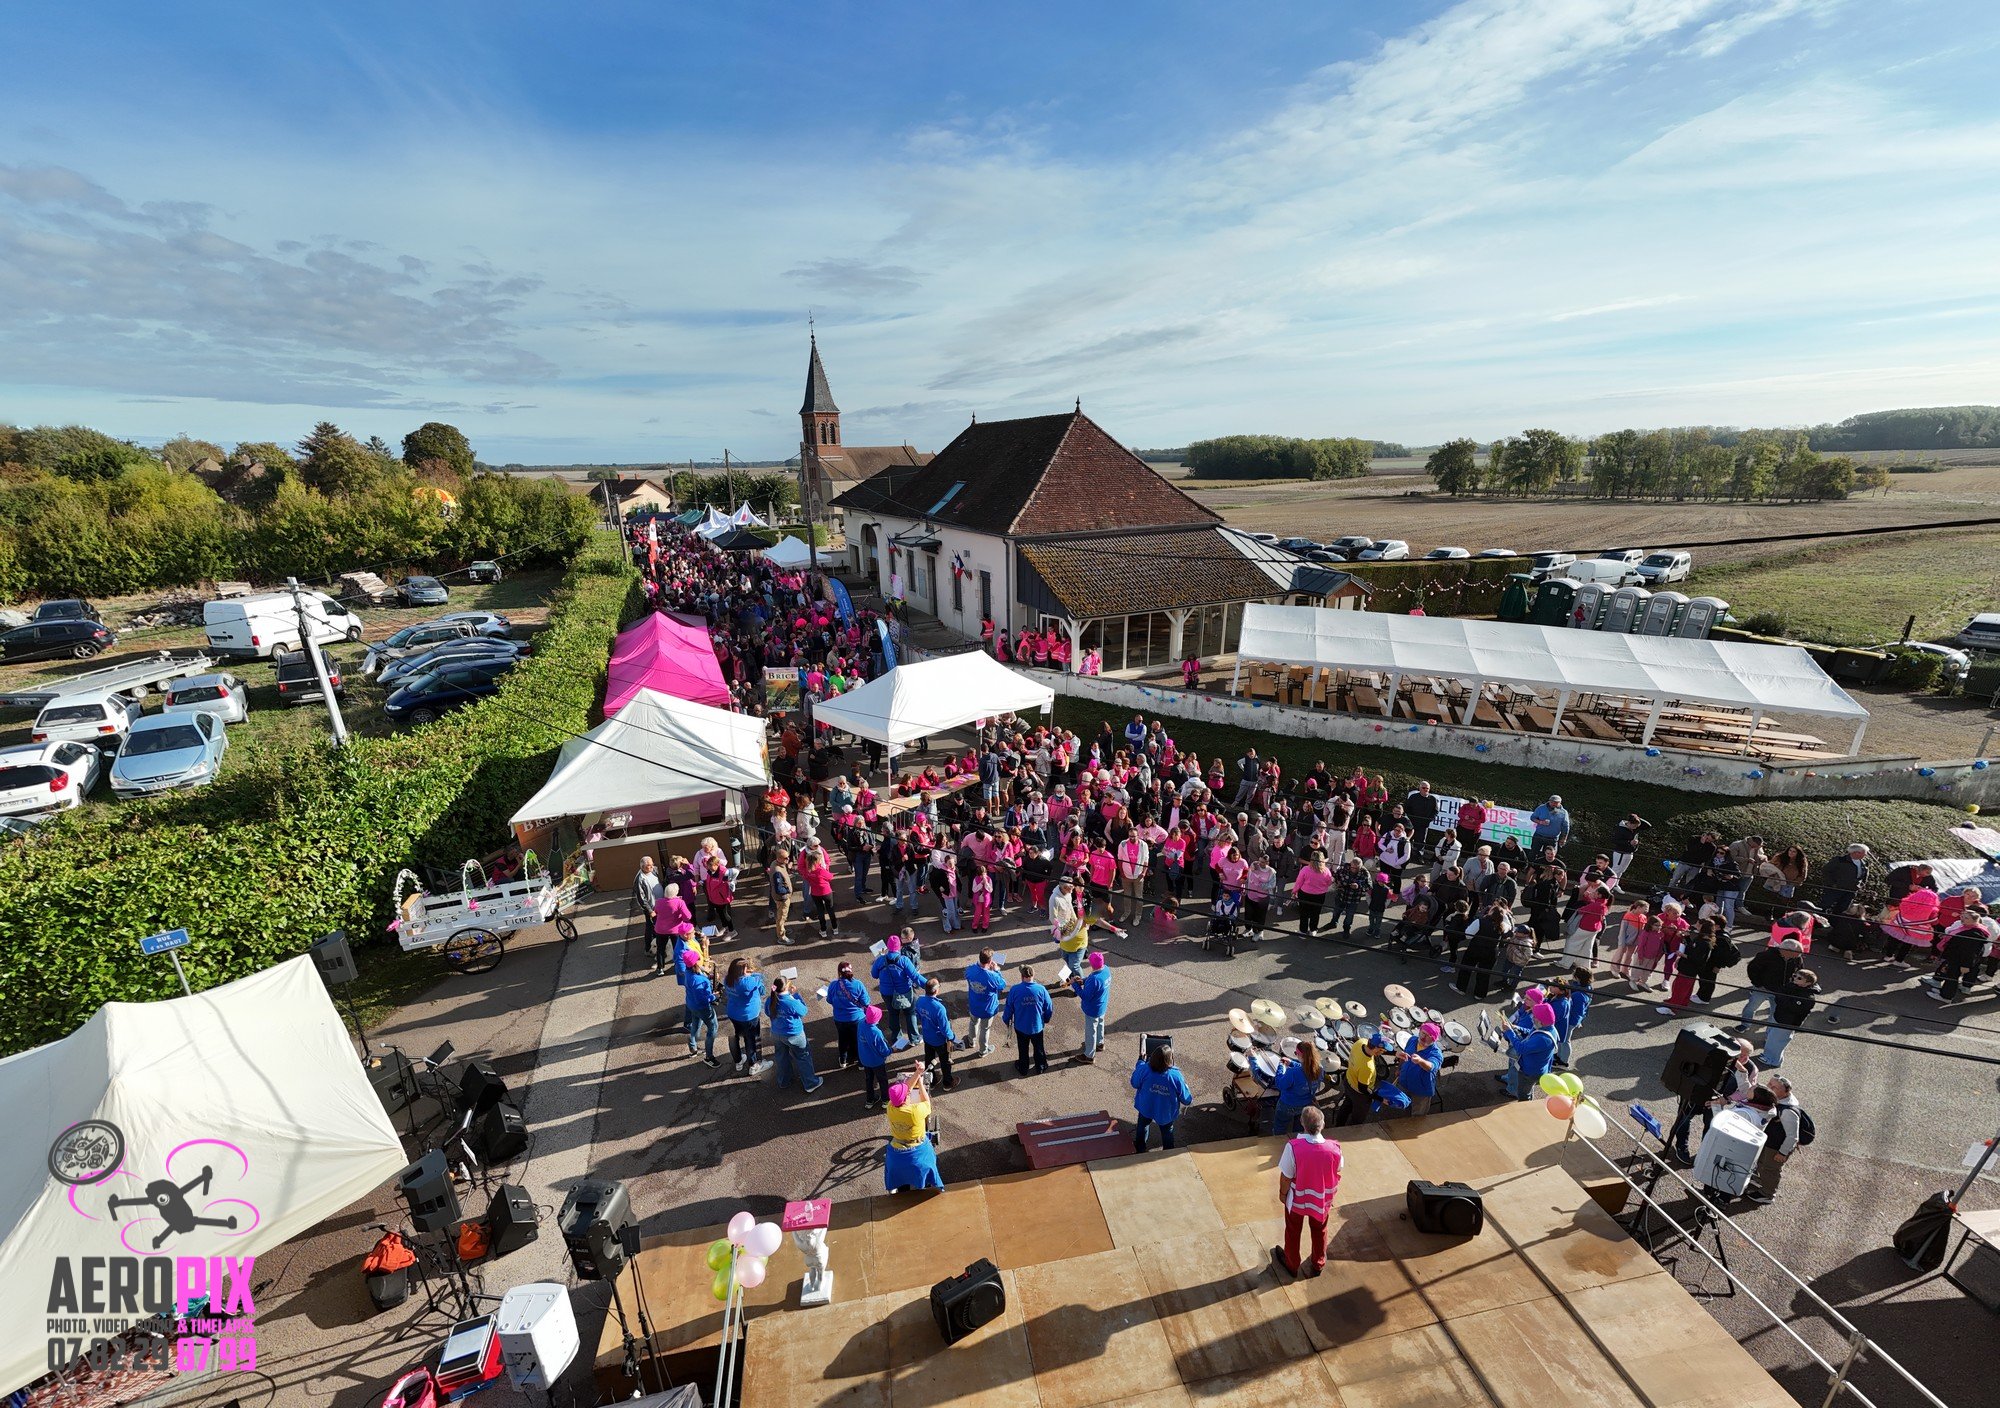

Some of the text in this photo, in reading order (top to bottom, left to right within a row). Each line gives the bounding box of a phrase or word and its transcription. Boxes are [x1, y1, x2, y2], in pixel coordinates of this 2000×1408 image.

[768, 672, 797, 680] BRICE
[1488, 808, 1518, 828] OSE
[411, 903, 522, 929] GROS BOIS
[156, 935, 172, 943] RUE
